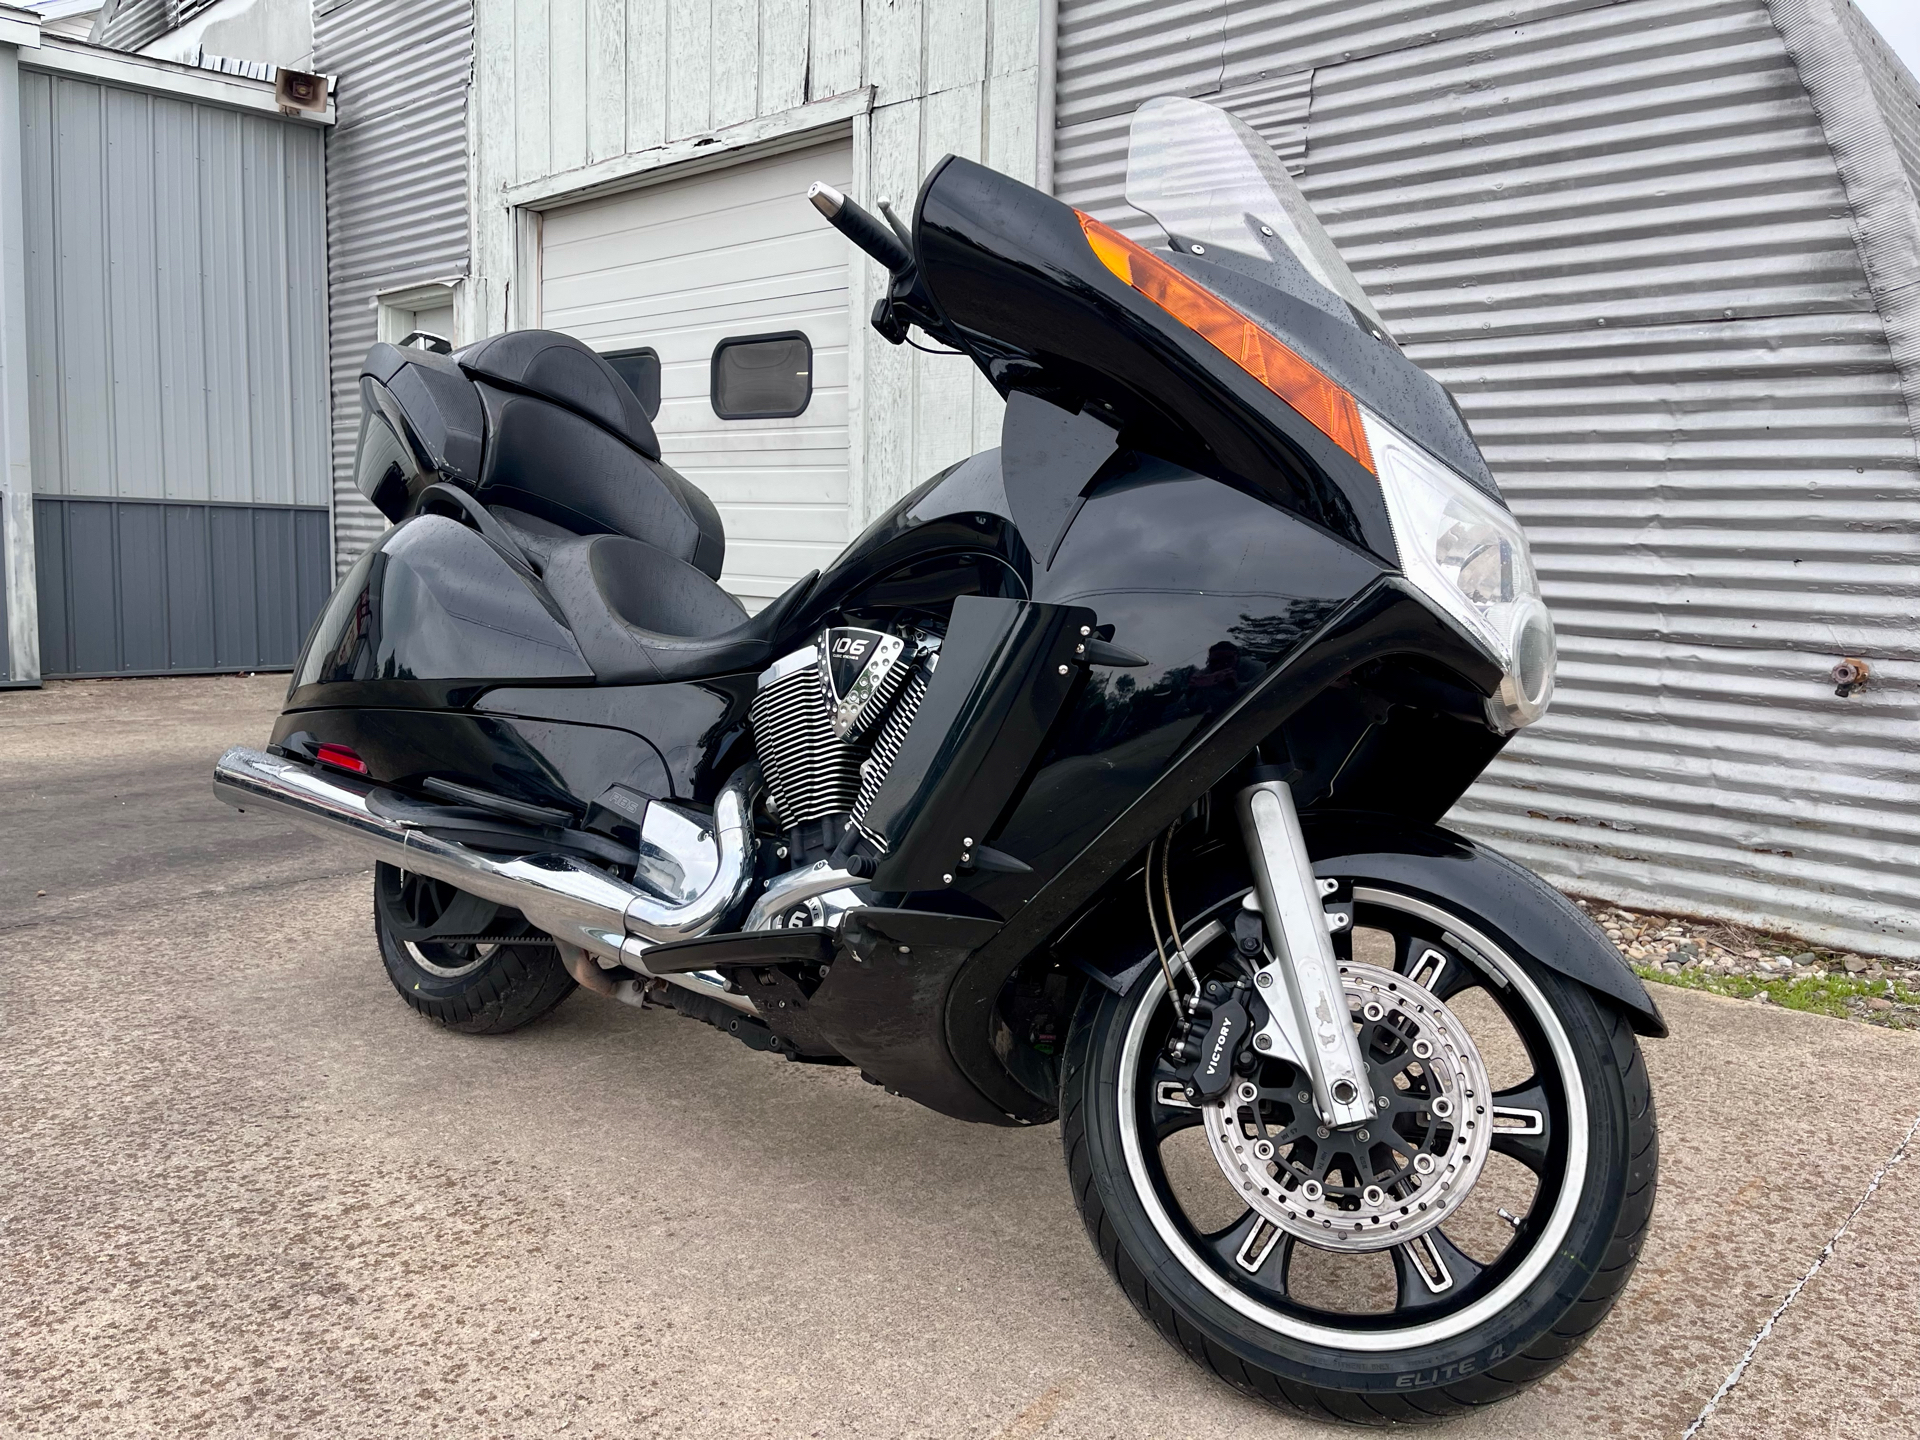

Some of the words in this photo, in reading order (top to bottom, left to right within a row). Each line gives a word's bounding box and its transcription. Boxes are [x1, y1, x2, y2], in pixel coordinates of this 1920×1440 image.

[831, 637, 870, 656] 106
[608, 791, 639, 814] ABS
[1206, 1017, 1232, 1075] VICTORY
[1395, 1357, 1476, 1388] ELITE
[1489, 1343, 1505, 1361] 4
